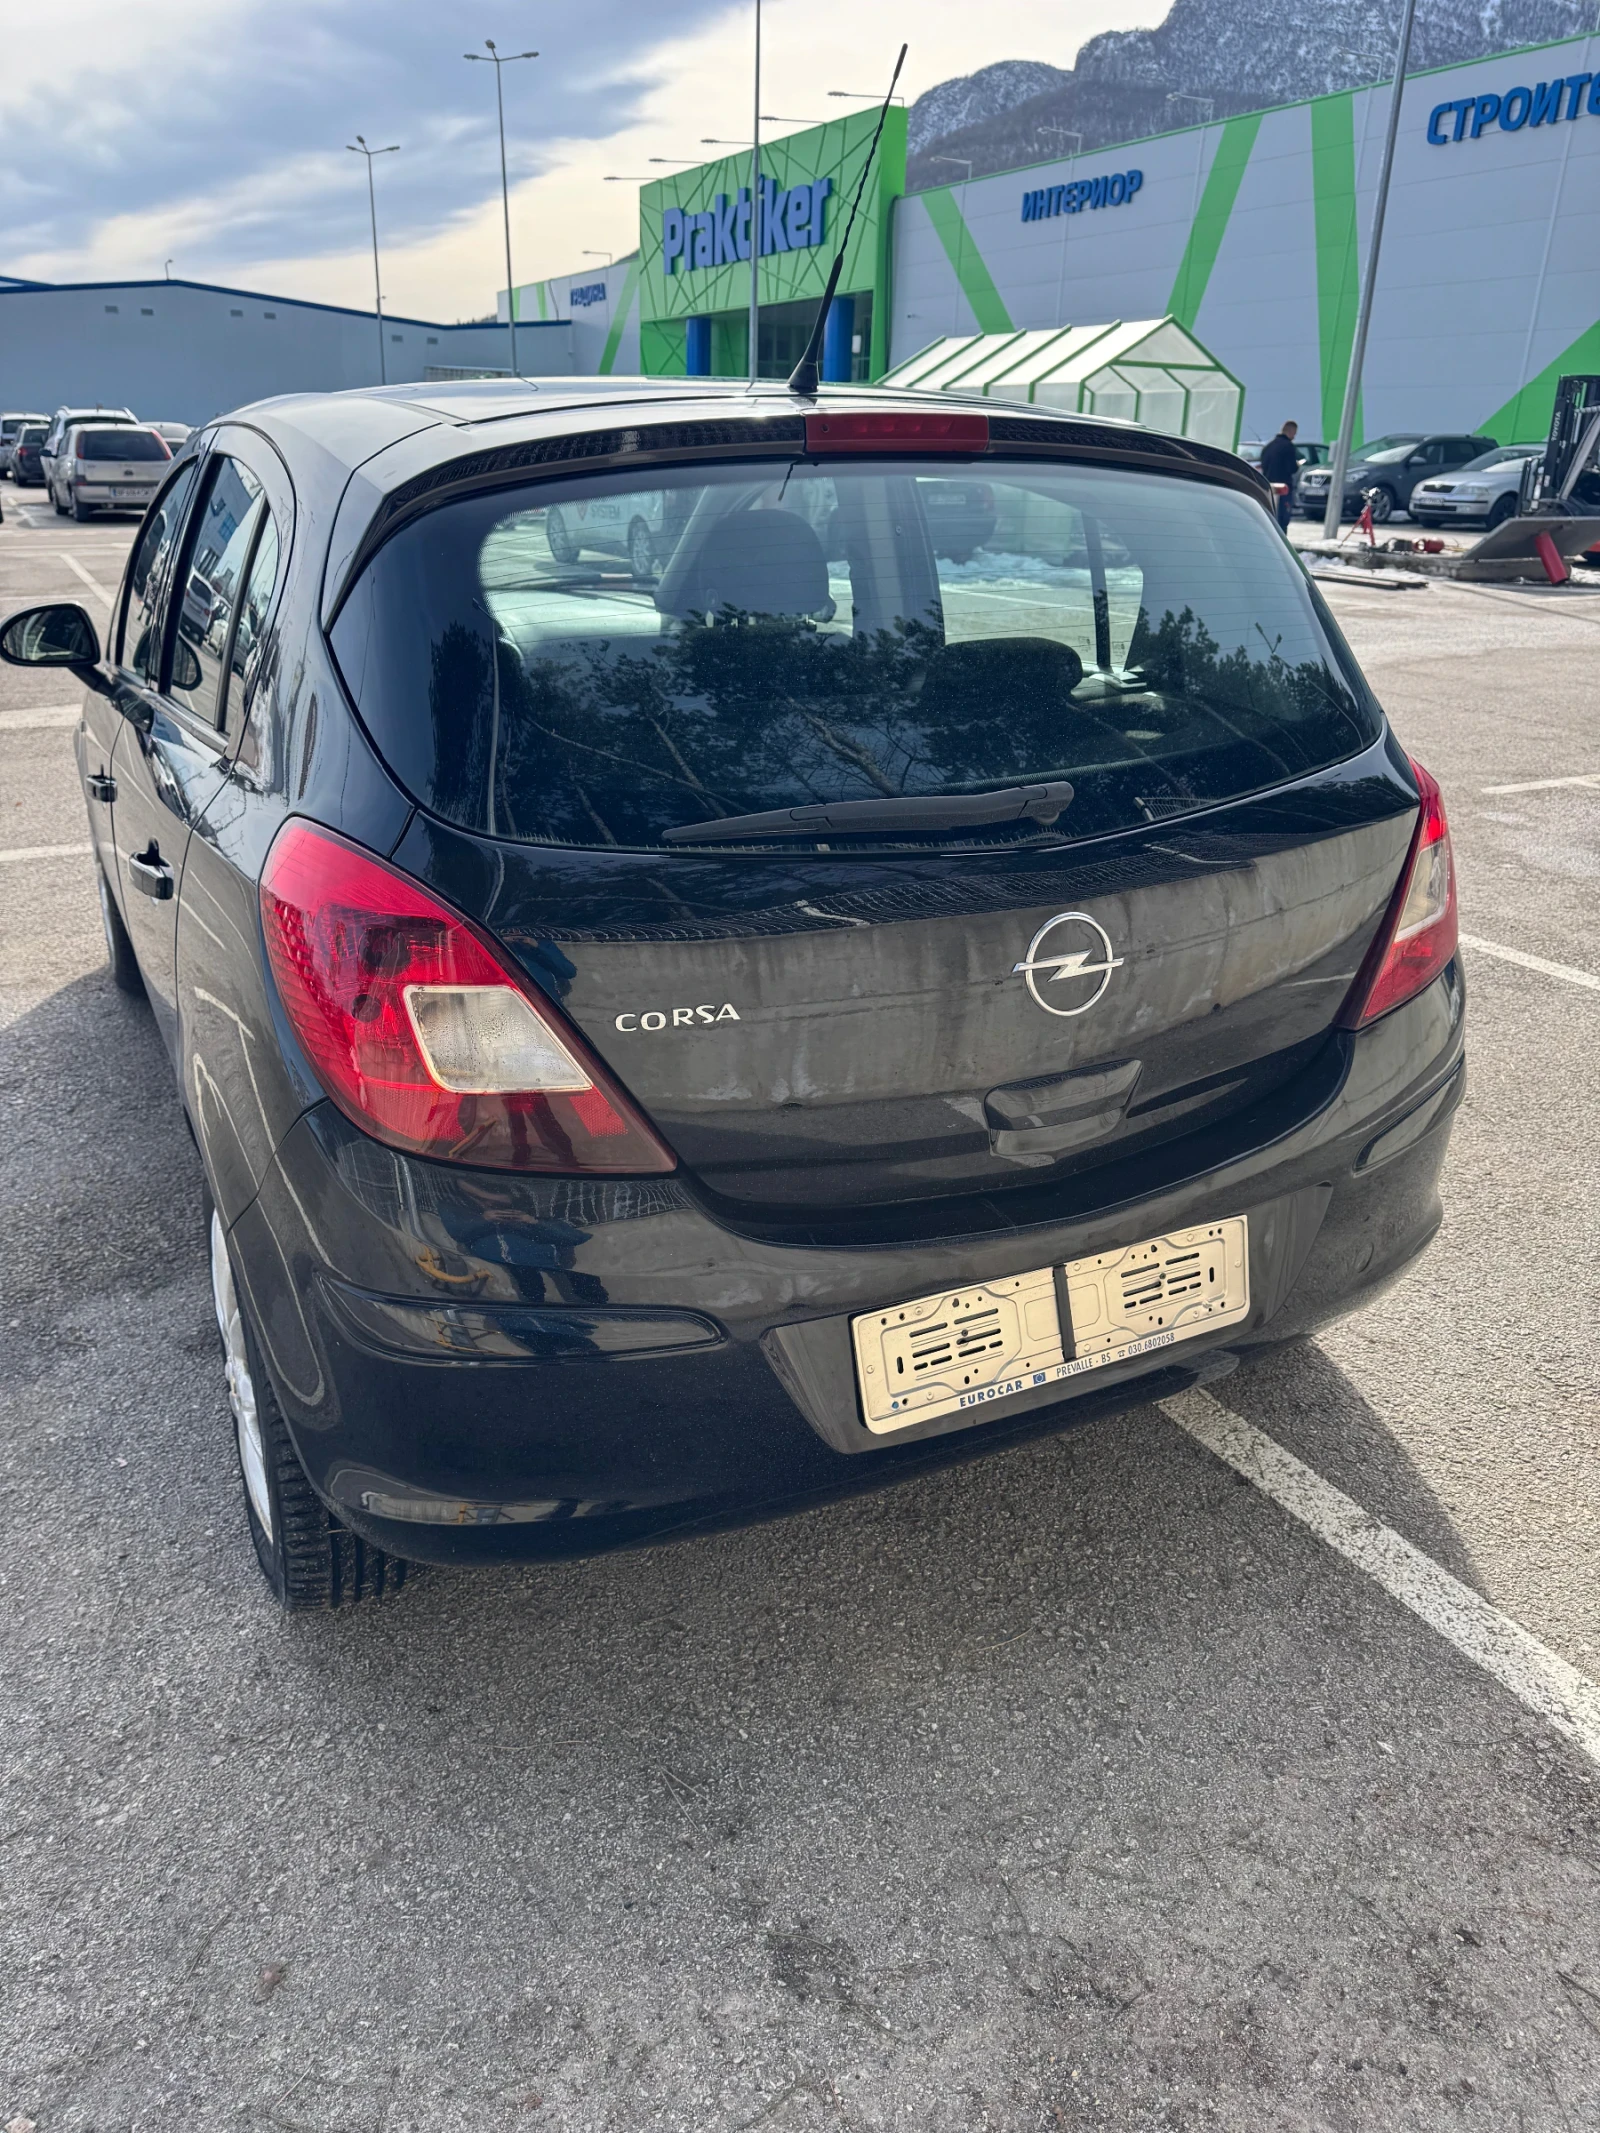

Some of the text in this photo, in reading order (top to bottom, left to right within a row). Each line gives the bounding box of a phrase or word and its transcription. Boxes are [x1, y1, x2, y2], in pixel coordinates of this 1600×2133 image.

[1022, 169, 1144, 221] ИНТЕРИОР
[614, 1003, 742, 1033] CORSA
[1056, 1358, 1093, 1377] PREVALLE
[1101, 1354, 1111, 1366] BS
[959, 1380, 1024, 1408] EUROCAR
